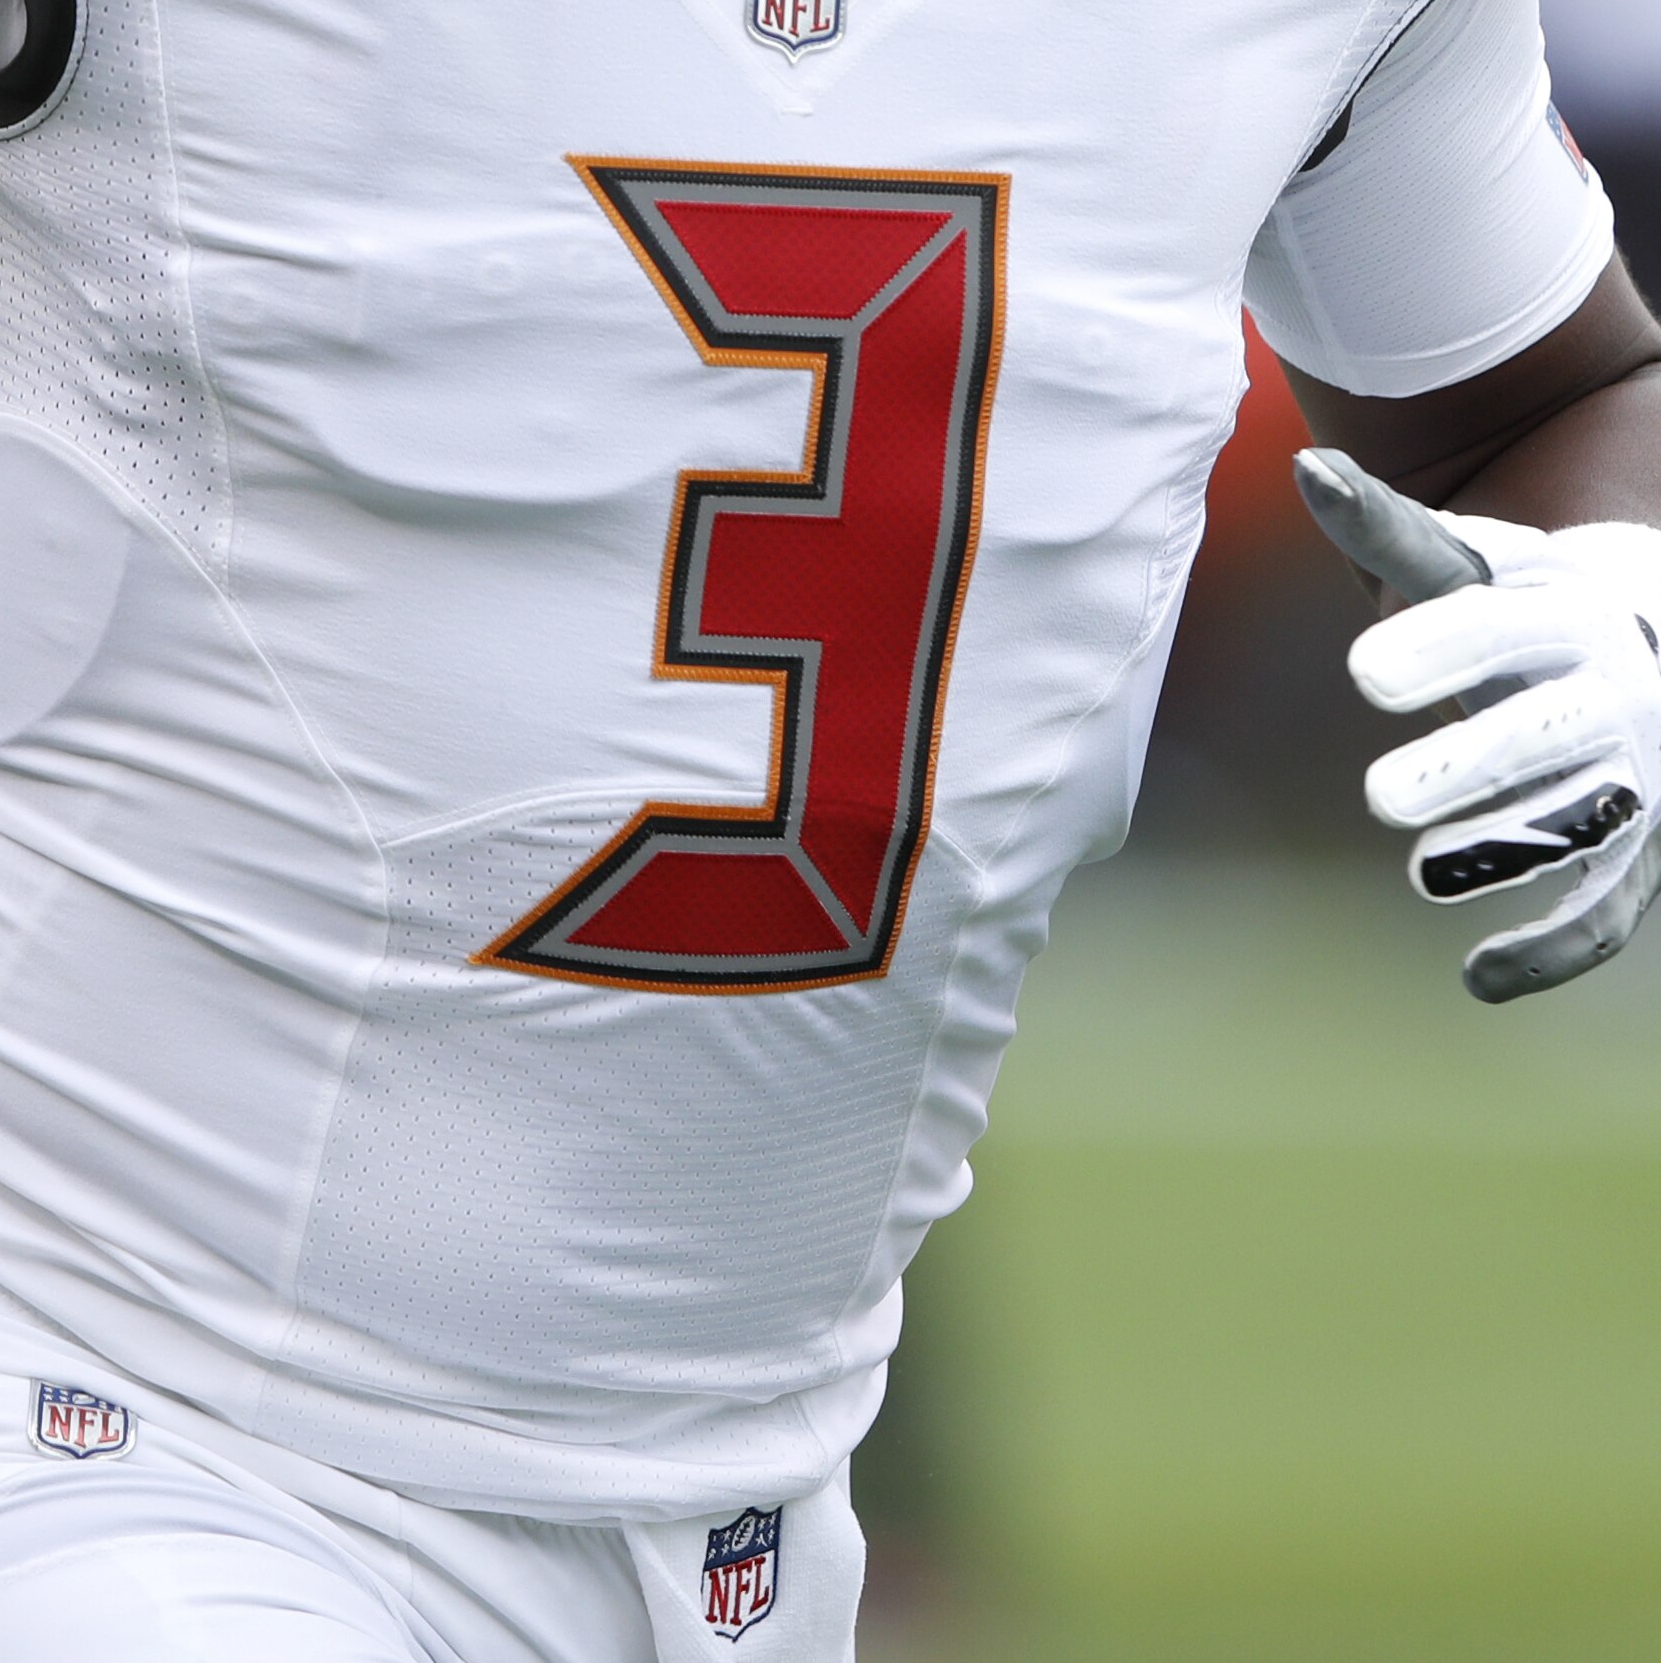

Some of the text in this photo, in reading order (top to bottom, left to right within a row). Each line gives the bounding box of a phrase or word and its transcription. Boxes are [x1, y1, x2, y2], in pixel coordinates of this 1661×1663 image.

[467, 153, 1012, 996] 3
[45, 1404, 120, 1449] NFL
[705, 1554, 770, 1626] NFL
